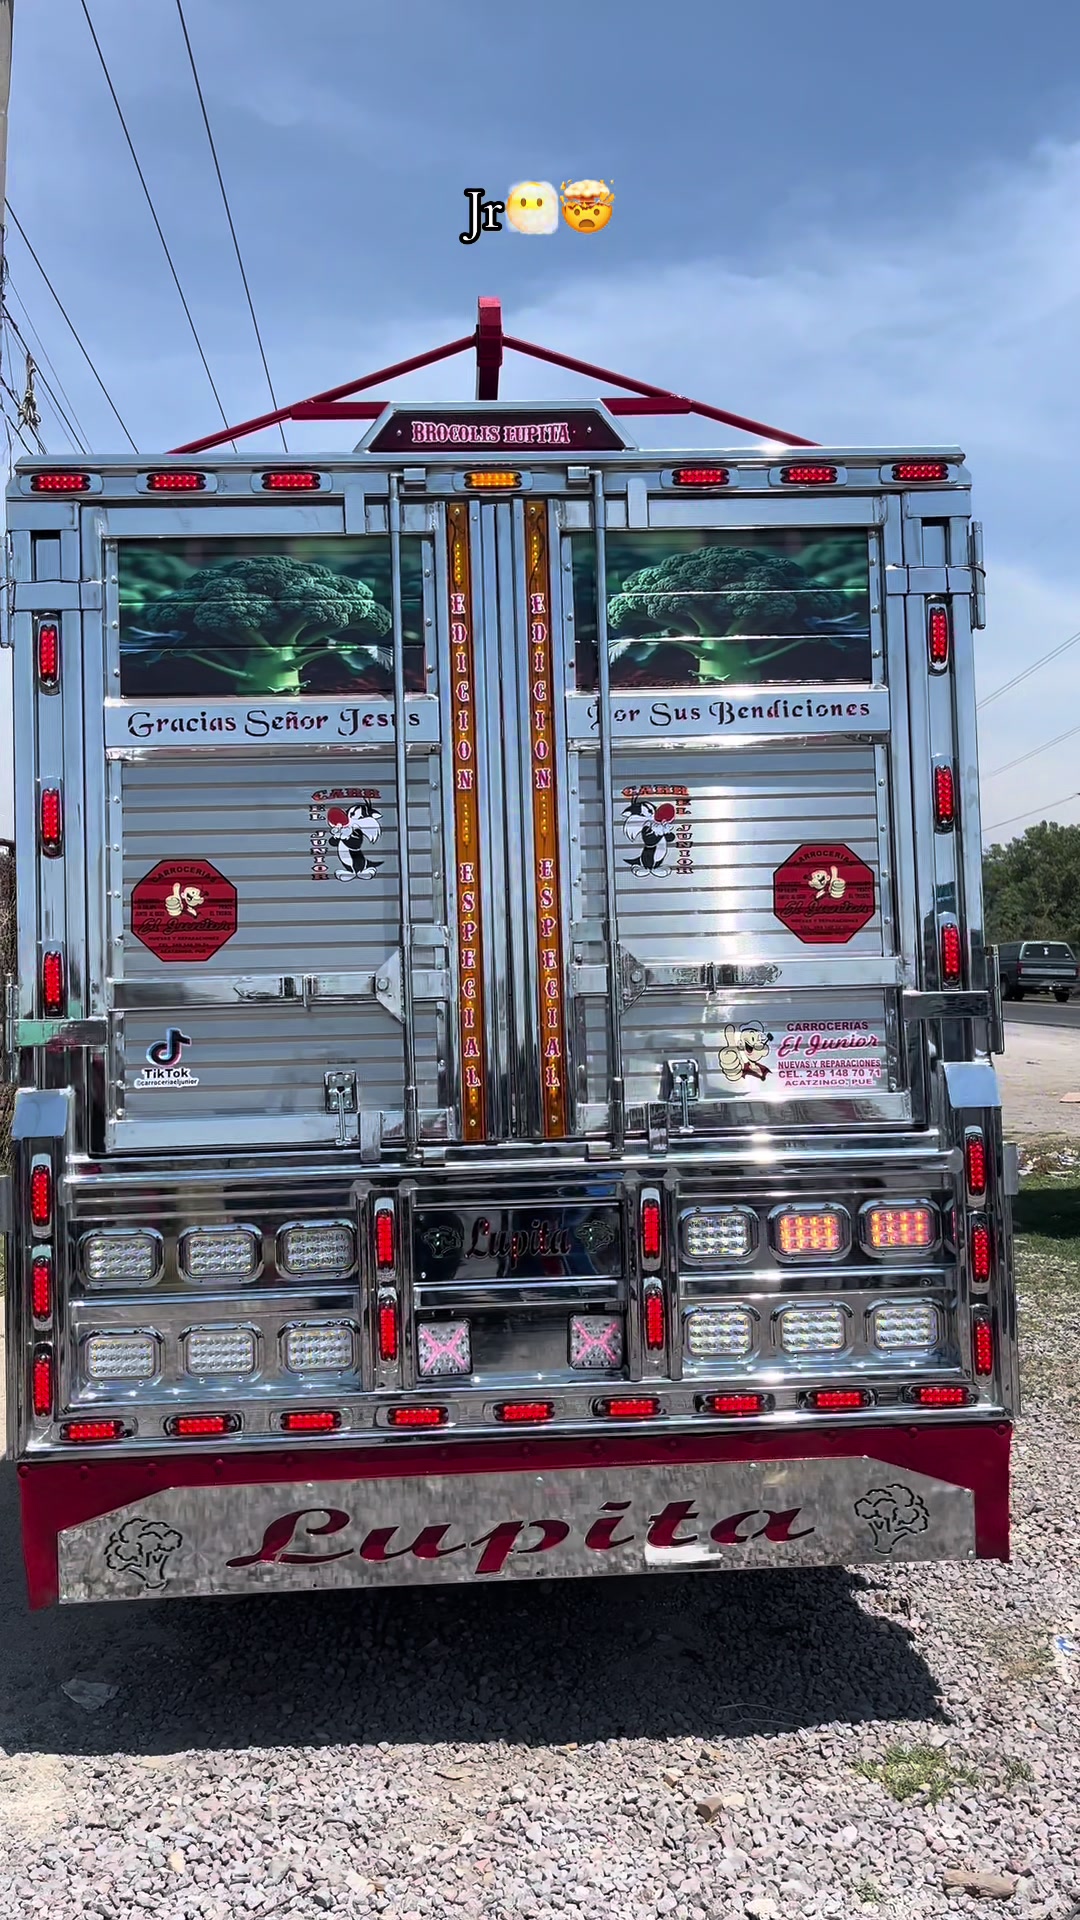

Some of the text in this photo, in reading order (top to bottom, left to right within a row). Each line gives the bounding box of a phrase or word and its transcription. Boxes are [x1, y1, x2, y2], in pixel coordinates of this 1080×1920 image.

[411, 421, 571, 444] BROCOLIS LUPITA
[128, 711, 236, 738] Gracias
[245, 709, 328, 737] Señor
[650, 703, 700, 727] Sus
[709, 700, 870, 725] Bendiciones
[451, 593, 481, 1087] EDICION ESPECIAL
[531, 593, 560, 1087] EDICION ESPECIAL
[787, 1021, 869, 1032] CARROCERIAS
[778, 1034, 878, 1057] El Junior
[144, 1068, 189, 1079] TikTok
[778, 1069, 880, 1078] CEL. 249 148 70 71
[820, 1059, 880, 1068] REPARACIONES
[464, 1216, 572, 1270] Lupita
[226, 1500, 815, 1574] Lupita
